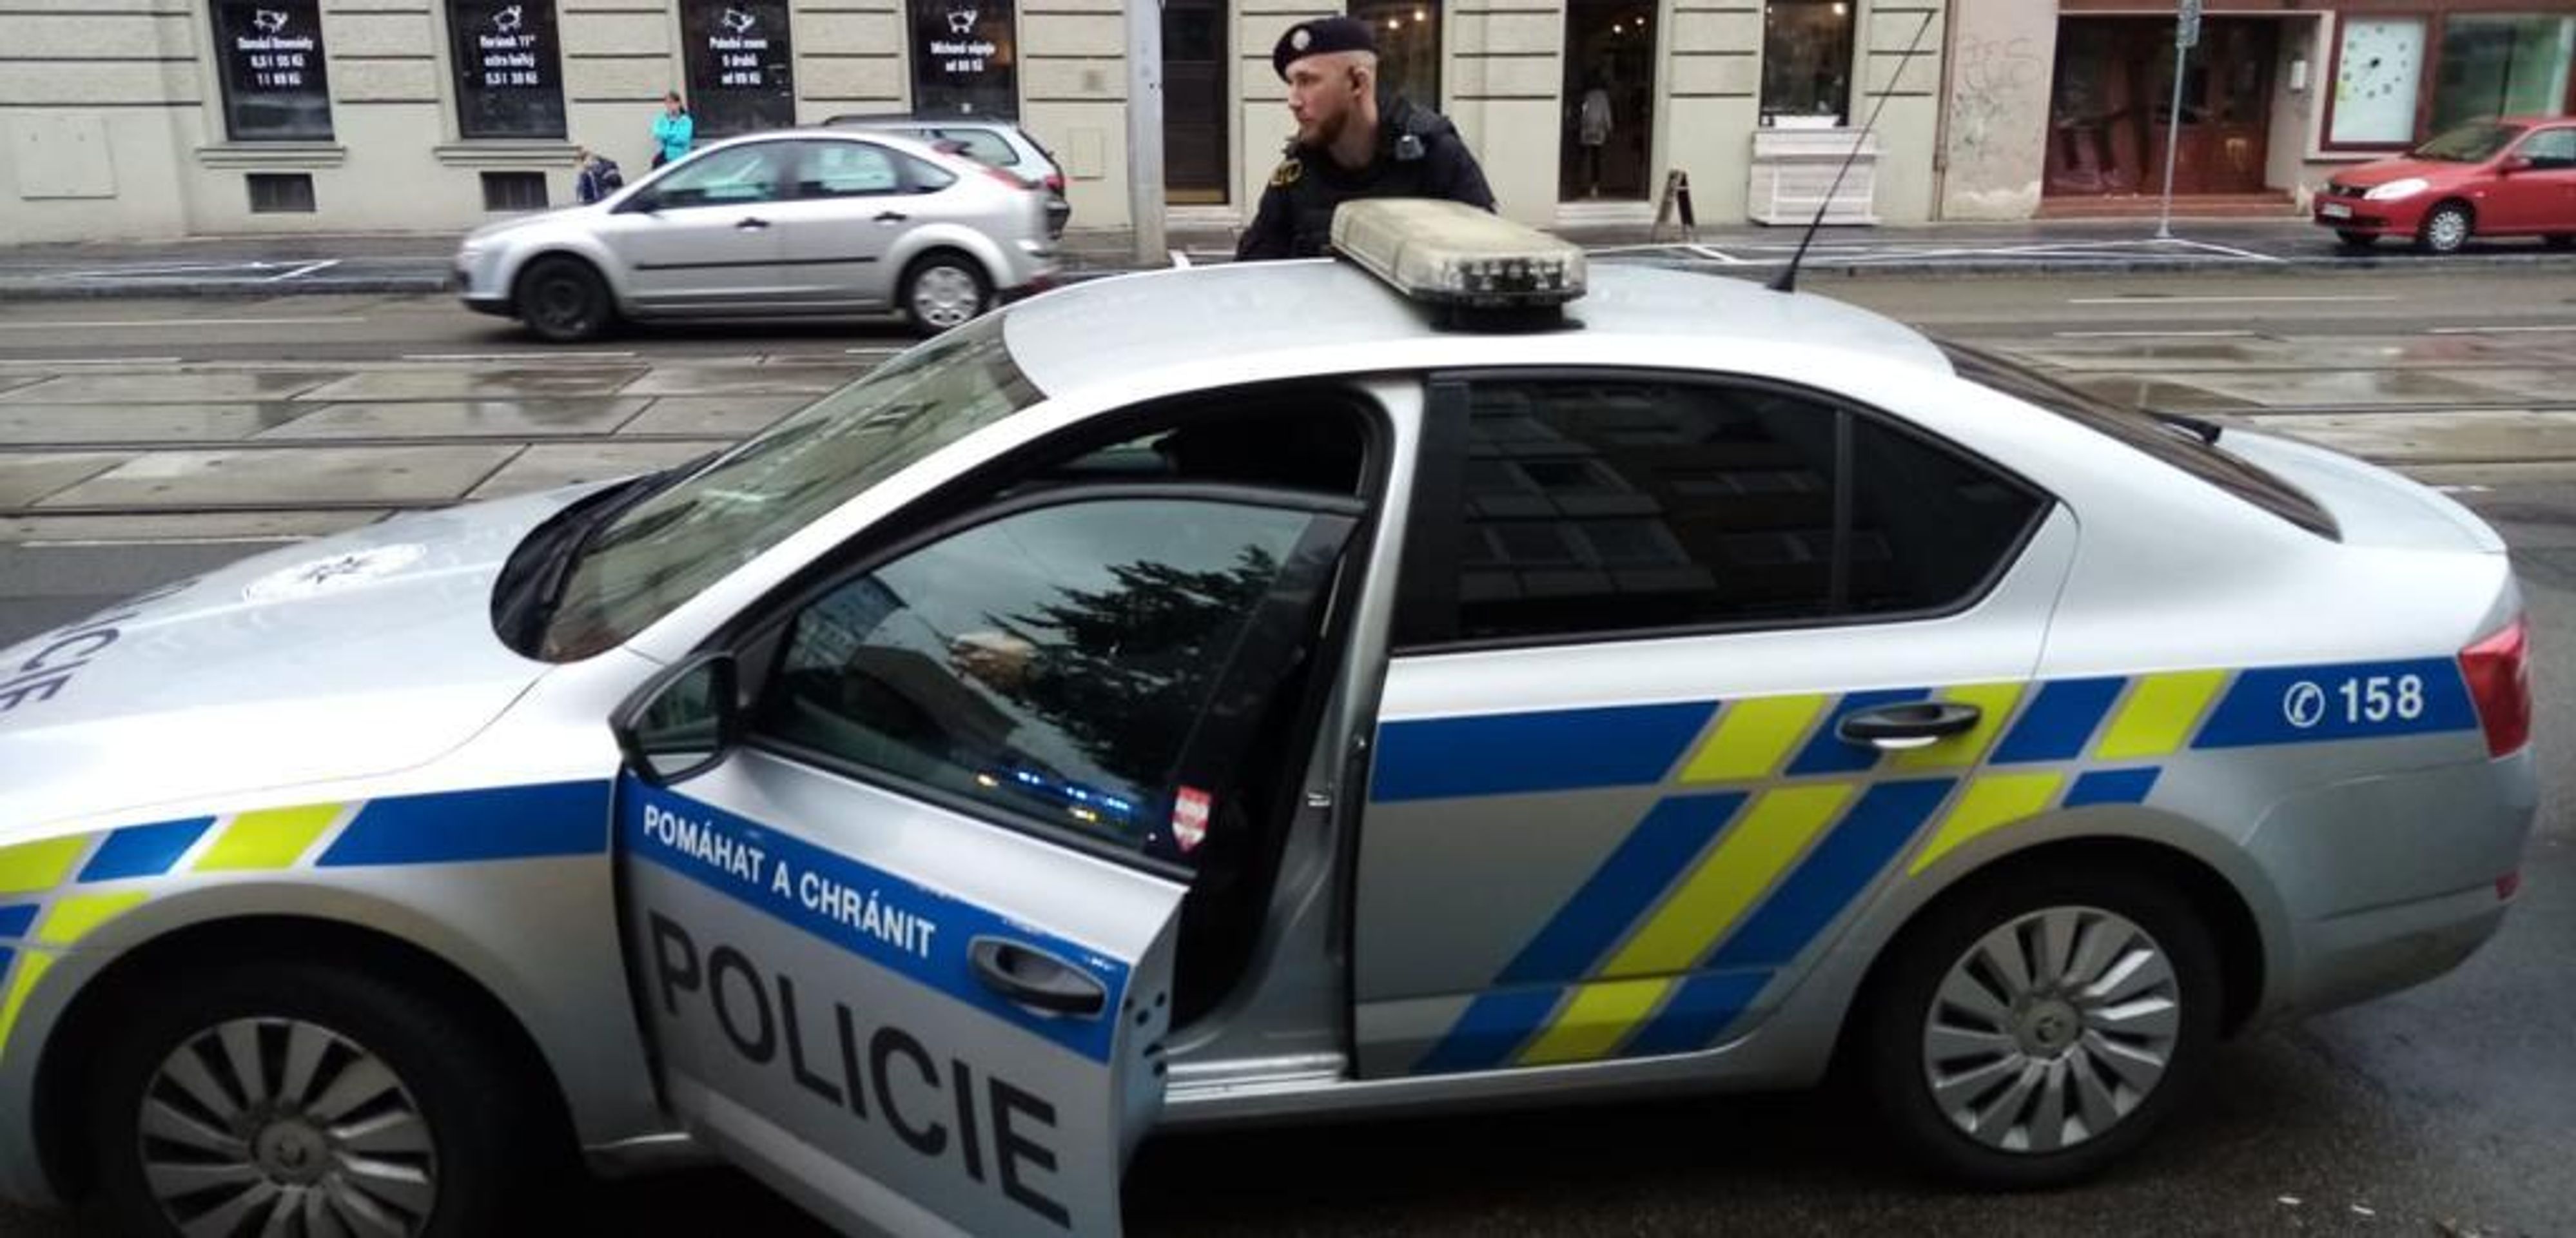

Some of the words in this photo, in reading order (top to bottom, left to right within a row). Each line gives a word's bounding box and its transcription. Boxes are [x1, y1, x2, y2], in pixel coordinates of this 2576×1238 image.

[2339, 674, 2424, 722] 158
[644, 805, 765, 883] POMÁHAT
[772, 861, 791, 898] A
[799, 872, 935, 958] CHRÁNIT
[649, 910, 1071, 1230] POLICIE
